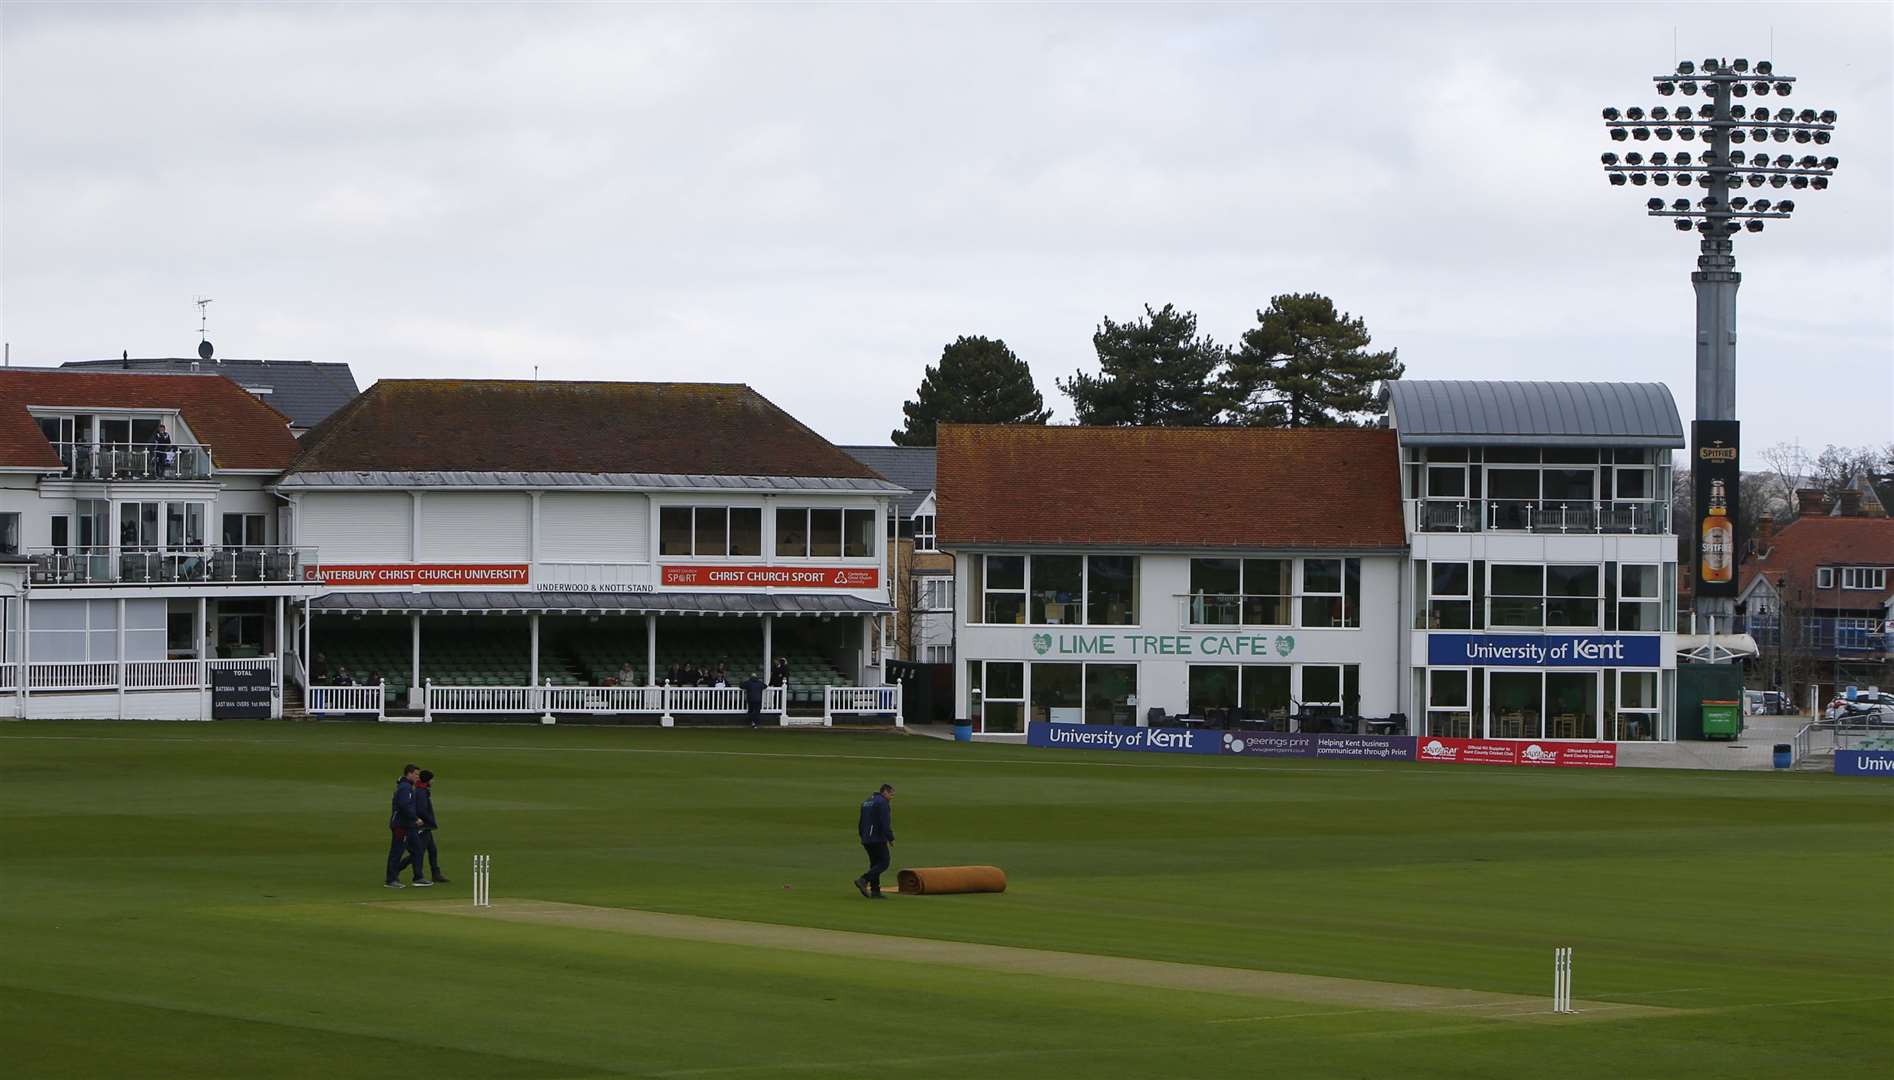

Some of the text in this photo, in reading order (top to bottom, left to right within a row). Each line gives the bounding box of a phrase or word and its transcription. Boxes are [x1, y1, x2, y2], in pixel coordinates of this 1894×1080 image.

[306, 569, 526, 581] CANTERBURY CHRIST CHURCH UNIVERSITY
[709, 571, 825, 583] CHRIST CHURCH SPORT
[536, 583, 653, 592] UNDERWOOD & KNOTT STAND
[1059, 635, 1115, 654] LIME
[1124, 635, 1193, 655] TREE
[1199, 633, 1267, 656] CAFÉ
[1466, 639, 1624, 663] University of Kent
[1050, 728, 1194, 749] University of Kent
[1246, 737, 1310, 747] geerings print
[1318, 739, 1344, 747] Helping
[1345, 739, 1361, 747] Kent
[1363, 748, 1390, 756] through
[1858, 756, 1894, 770] Univ
